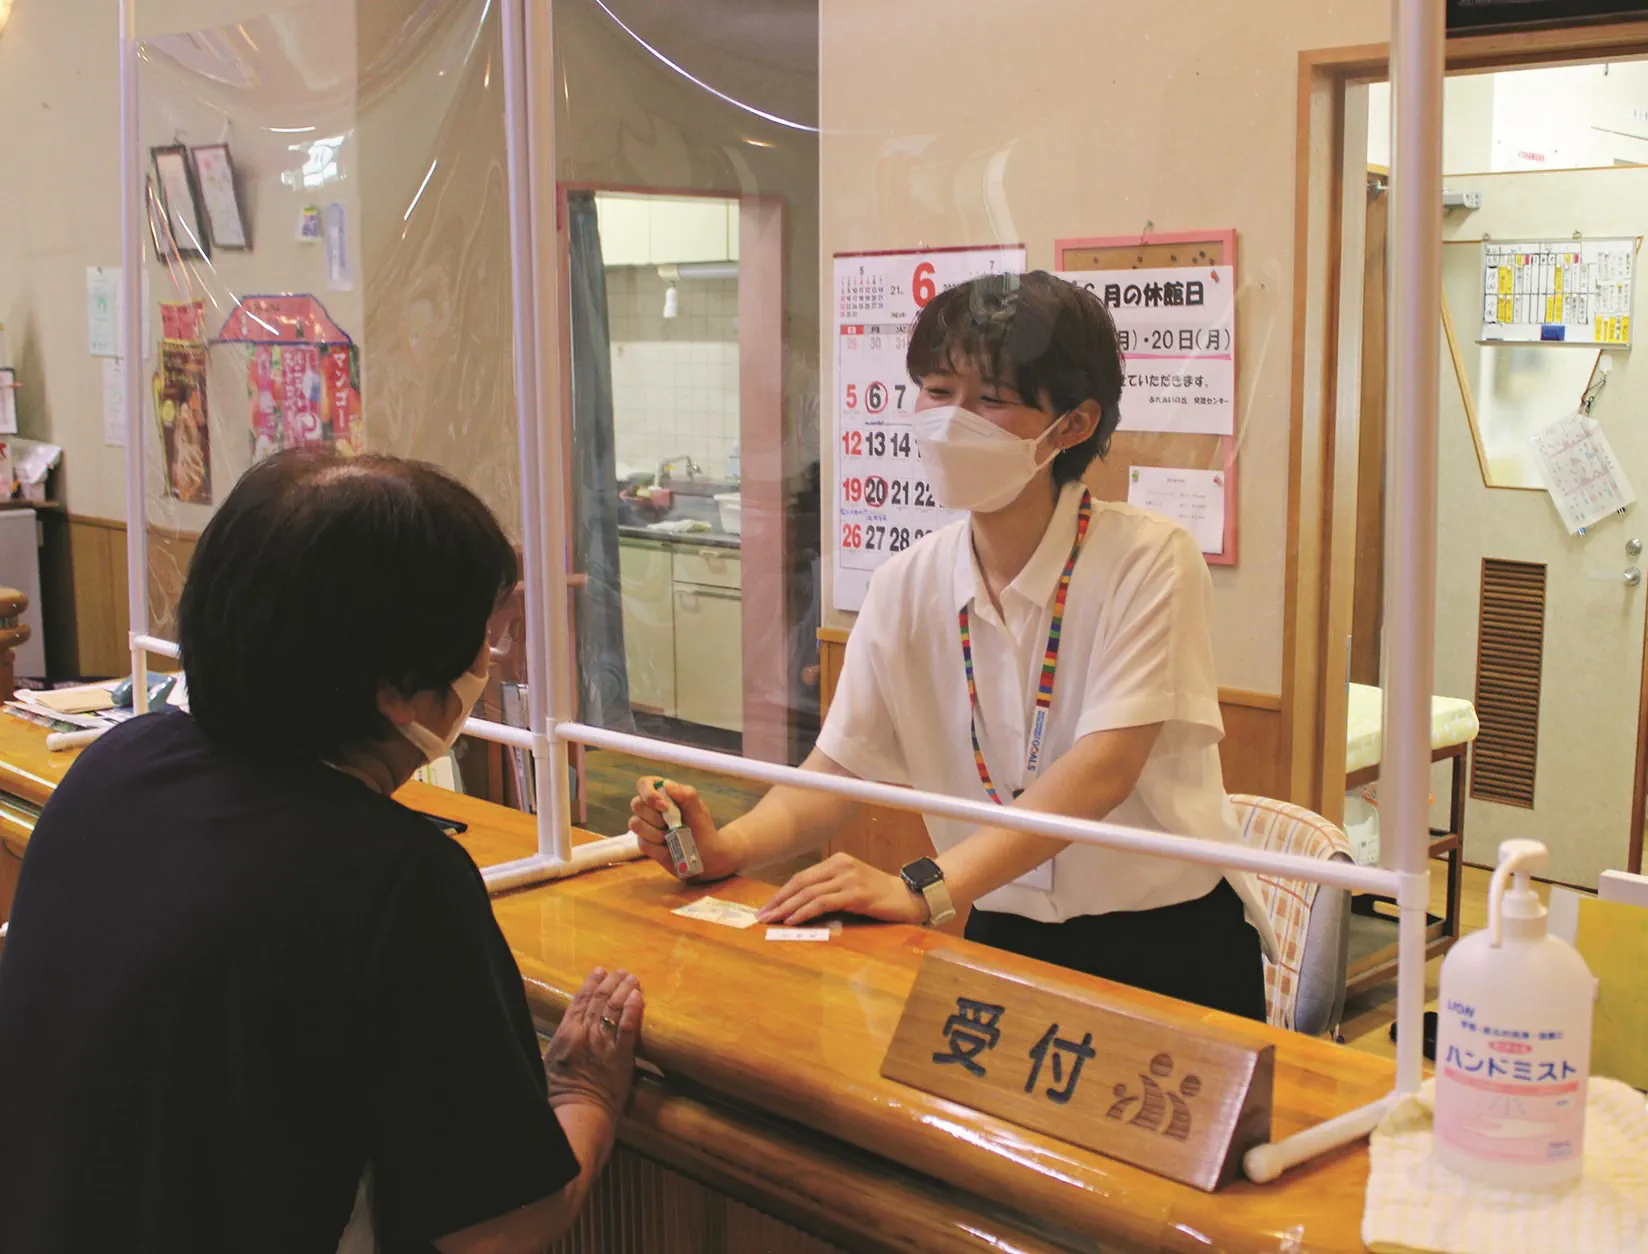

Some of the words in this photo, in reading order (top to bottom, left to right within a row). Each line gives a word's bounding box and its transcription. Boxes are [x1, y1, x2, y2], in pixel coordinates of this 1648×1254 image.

[912, 262, 936, 308] 6
[333, 352, 349, 429] マンゴー
[846, 384, 857, 409] 5
[869, 384, 881, 409] 6
[894, 385, 906, 410] 7
[842, 431, 862, 456] 12
[865, 431, 886, 457] 13
[890, 432, 911, 458] 14
[843, 478, 861, 502] 19
[864, 478, 886, 506] 20
[891, 480, 909, 505] 21
[914, 481, 935, 507] 22
[842, 523, 861, 548] 26
[865, 525, 885, 550] 27
[889, 527, 910, 552] 28
[931, 996, 1097, 1104] 受付
[1446, 1044, 1577, 1081] ハンドミスト
